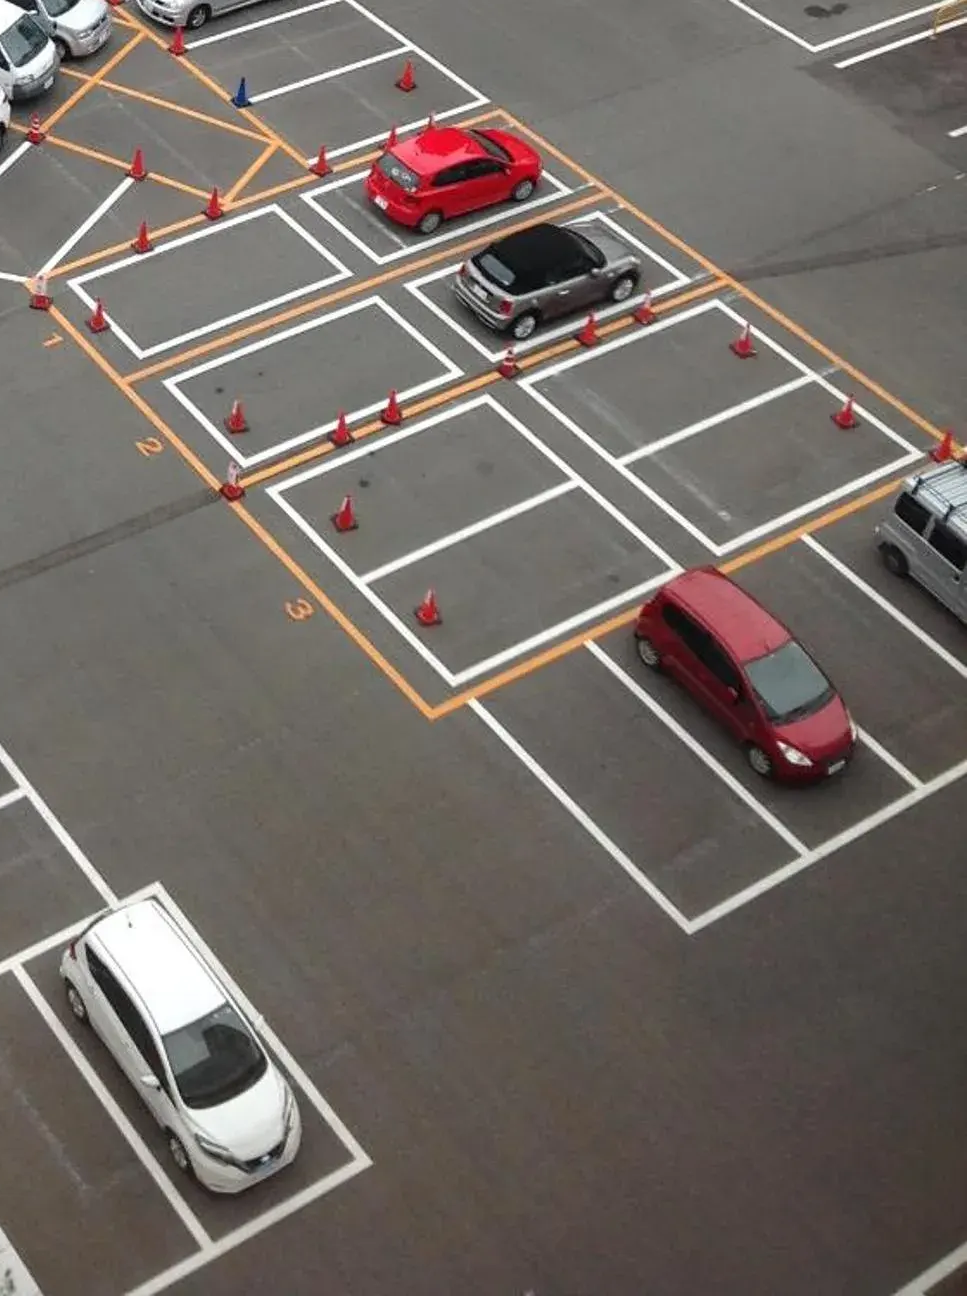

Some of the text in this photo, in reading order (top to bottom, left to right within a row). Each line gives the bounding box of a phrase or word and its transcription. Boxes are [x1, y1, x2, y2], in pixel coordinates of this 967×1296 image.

[42, 332, 64, 348] 1
[135, 436, 165, 456] 2
[284, 597, 315, 622] 3
